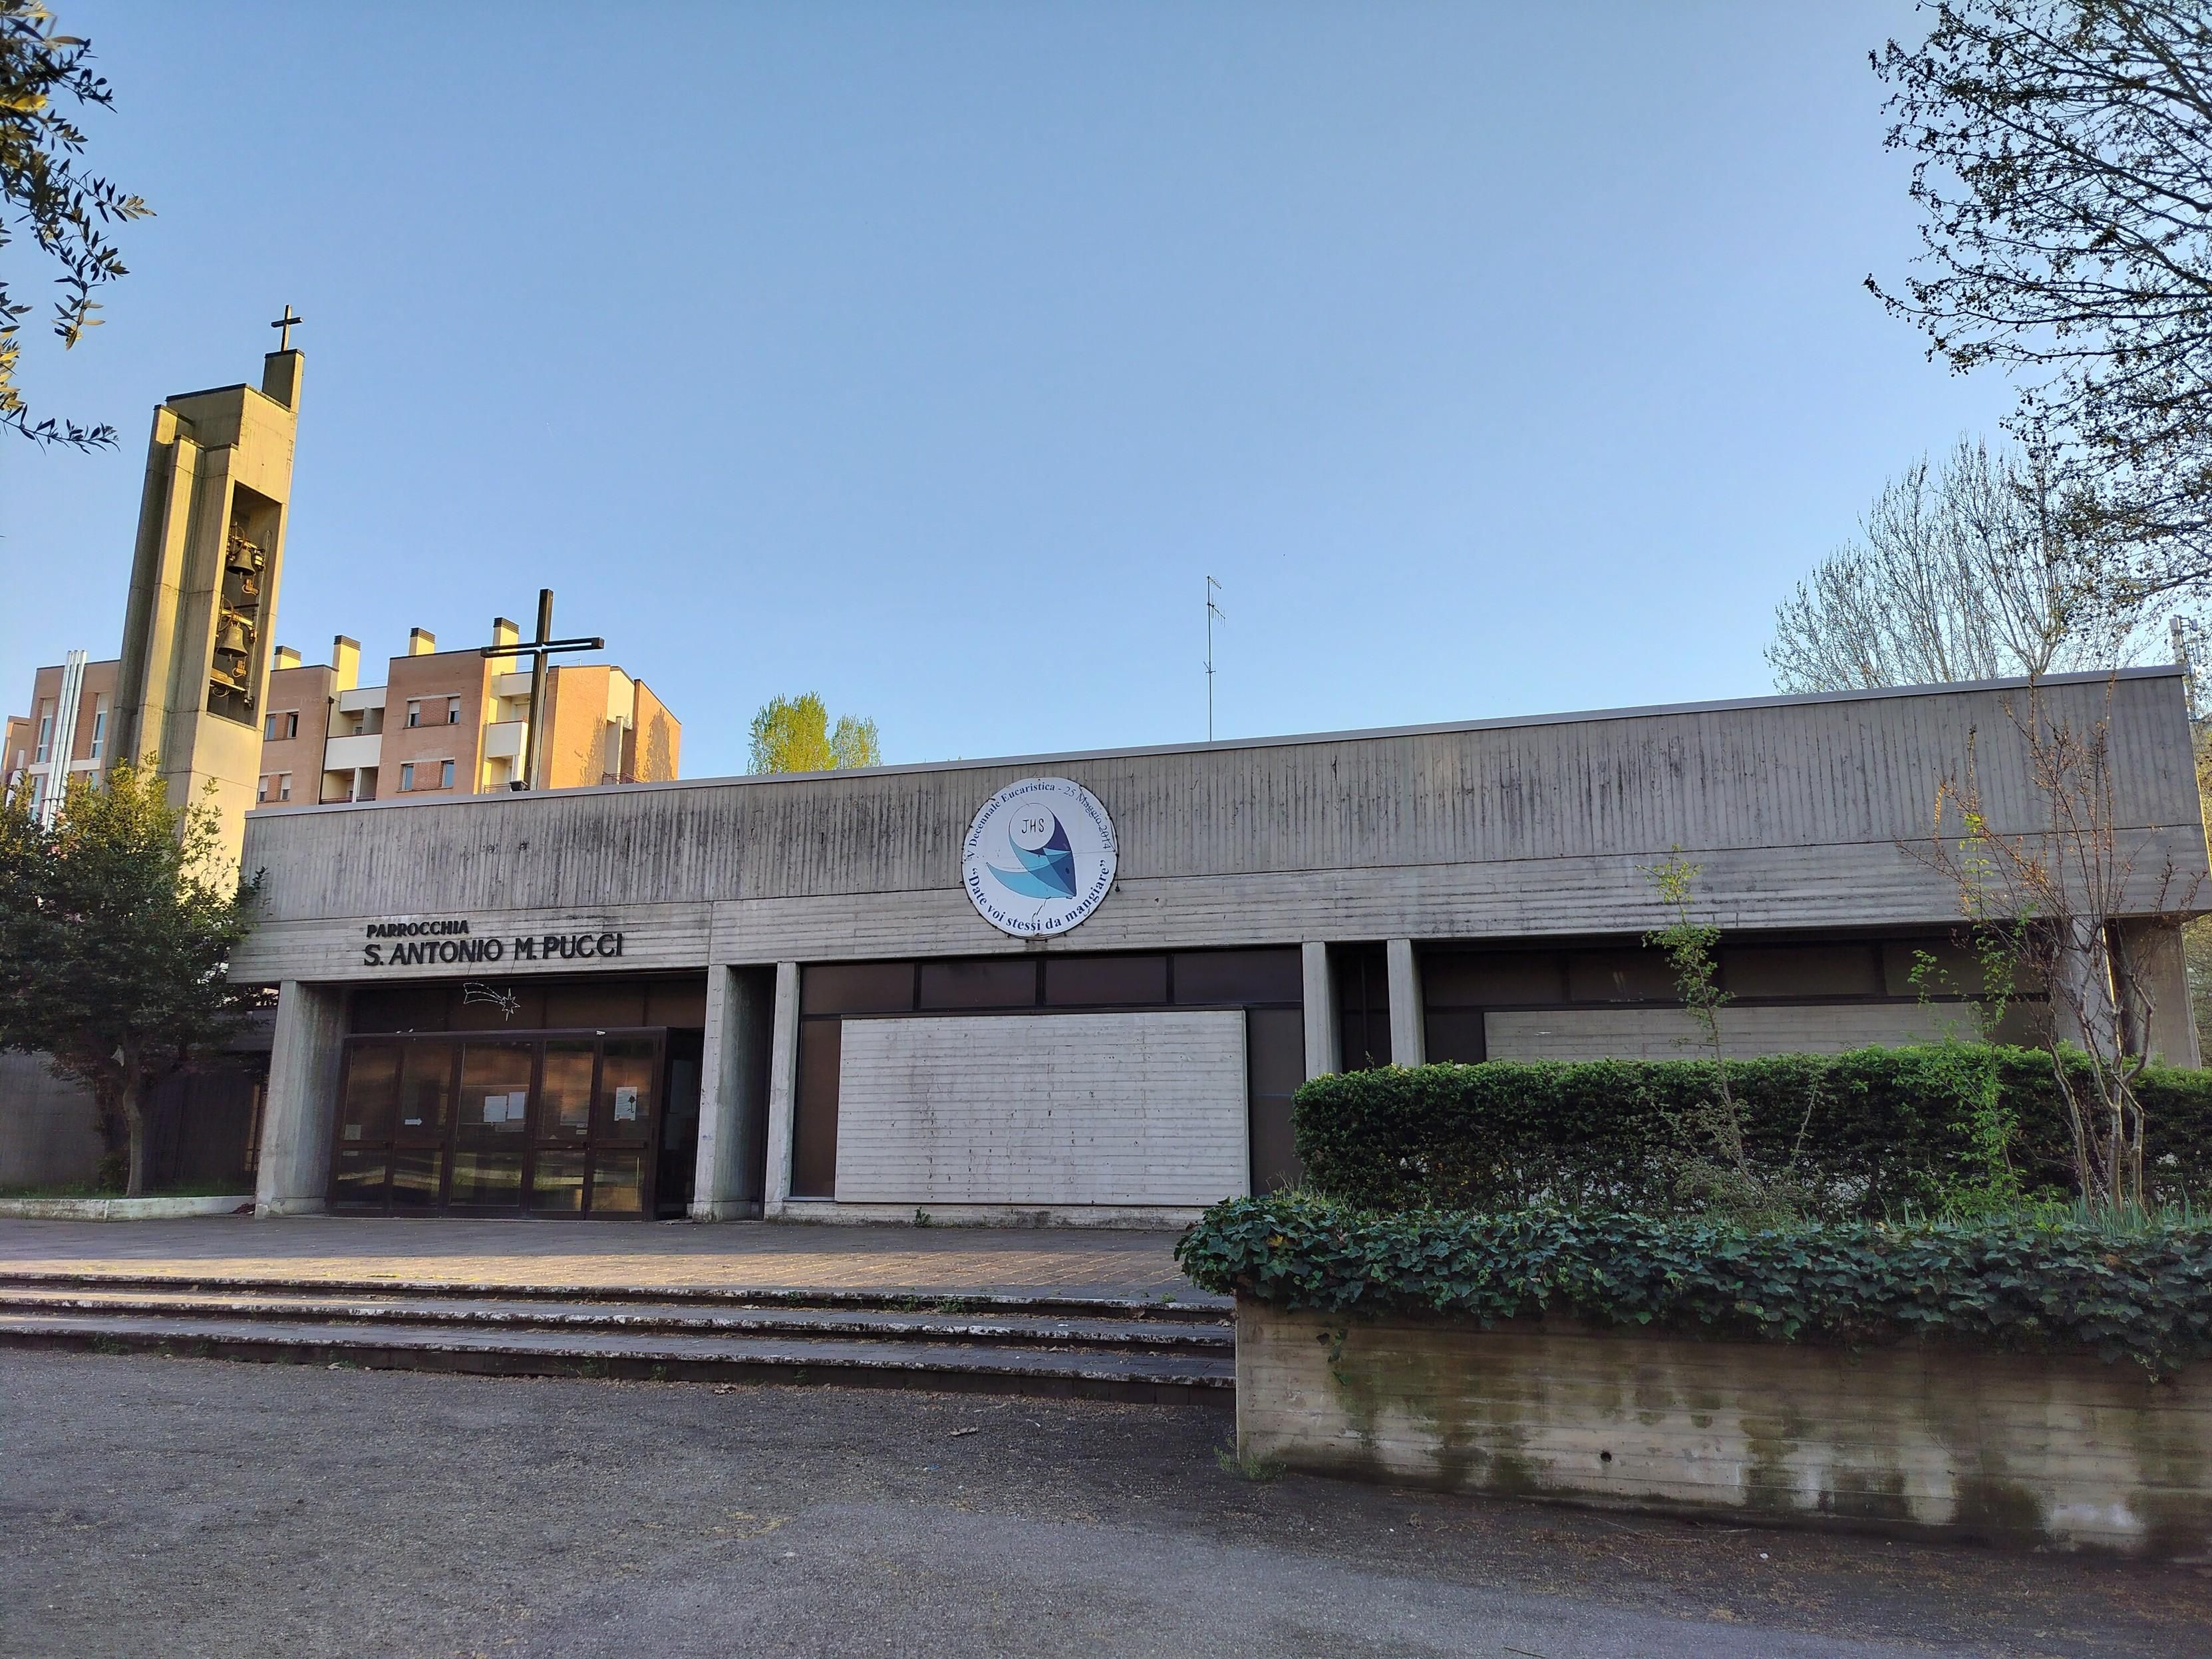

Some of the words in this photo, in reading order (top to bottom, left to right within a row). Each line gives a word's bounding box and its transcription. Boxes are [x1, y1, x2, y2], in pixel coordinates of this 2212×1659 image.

[969, 801, 1001, 847] Decennale
[1001, 782, 1055, 803] Eucaristica
[1063, 786, 1076, 798] 25
[1076, 792, 1102, 825] Maggio
[1098, 825, 1111, 849] 2014
[1021, 818, 1044, 833] JHS
[367, 920, 469, 938] PARROCCHIA
[987, 905, 1006, 922] voi
[1006, 917, 1040, 931] stessi
[1045, 918, 1062, 929] da
